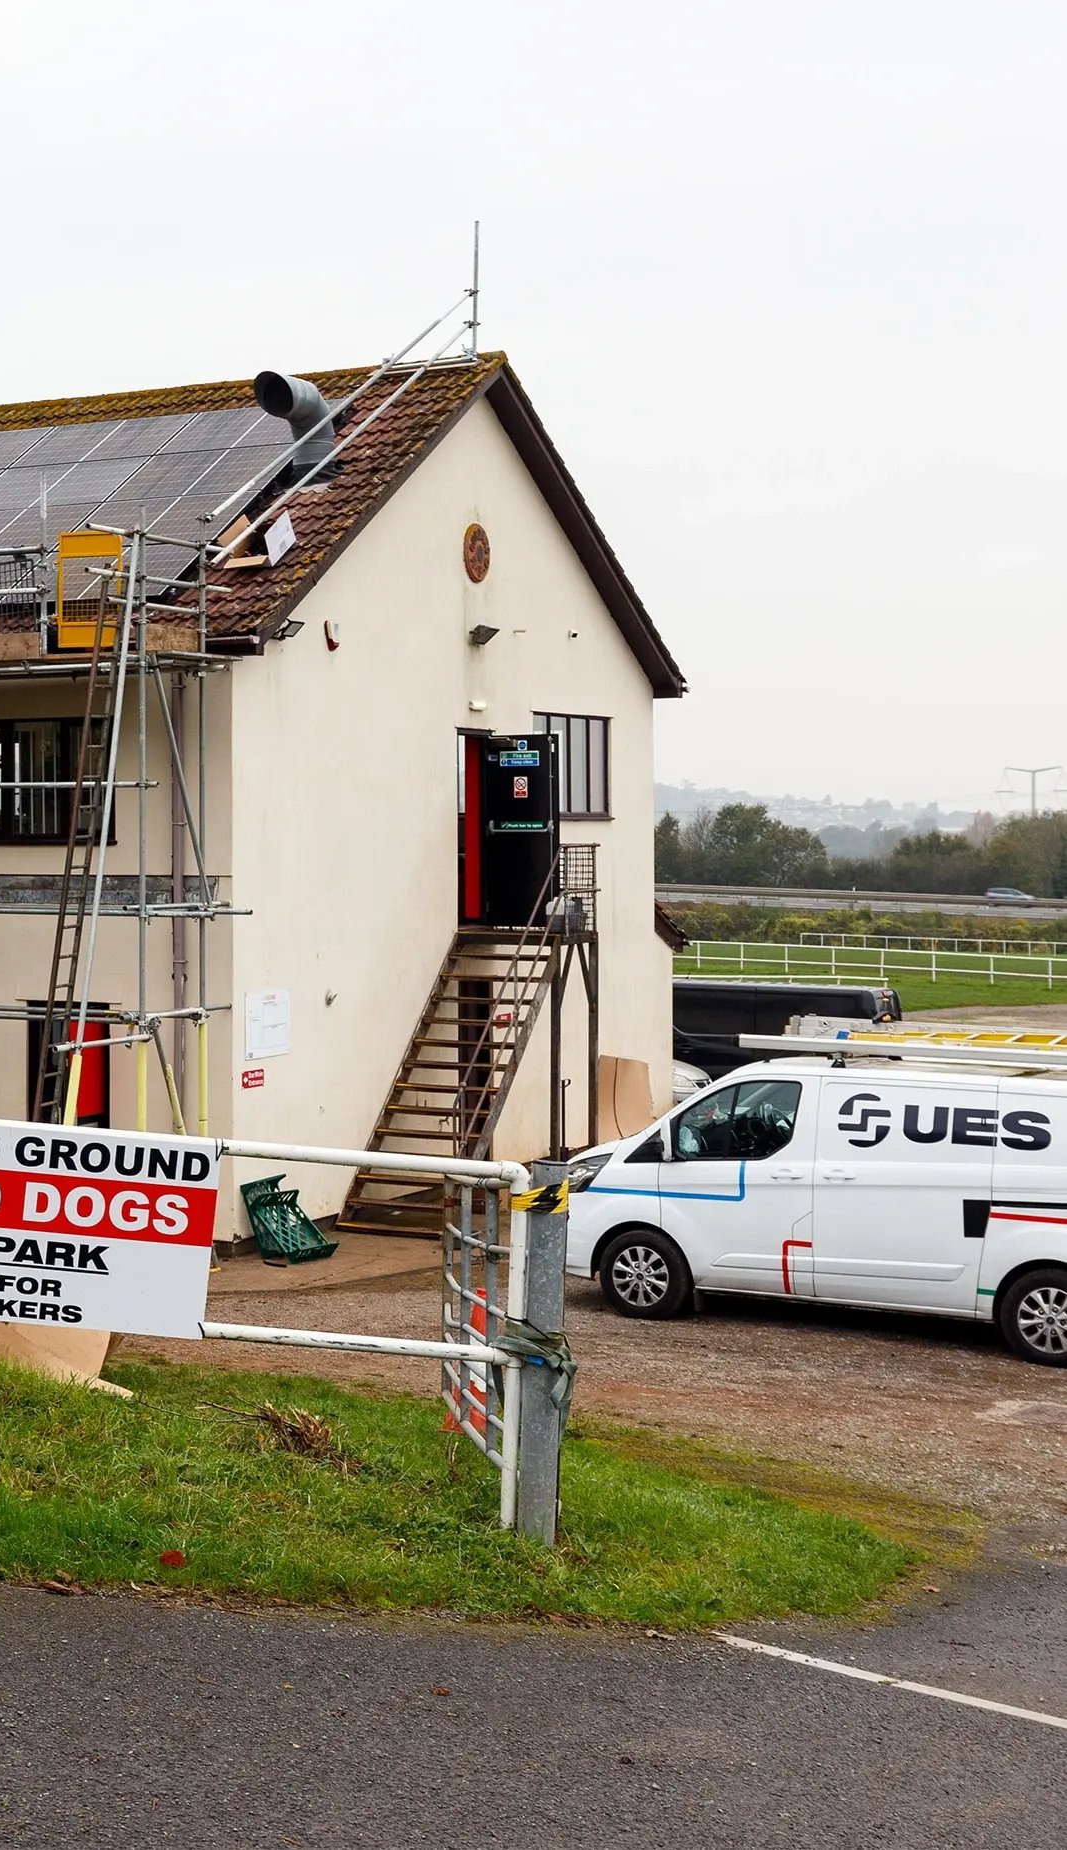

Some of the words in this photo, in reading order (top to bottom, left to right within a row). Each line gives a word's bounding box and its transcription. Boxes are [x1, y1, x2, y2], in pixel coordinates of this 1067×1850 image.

[902, 1104, 1052, 1151] UES
[15, 1136, 210, 1181] GROUND
[22, 1181, 189, 1236] DOGS
